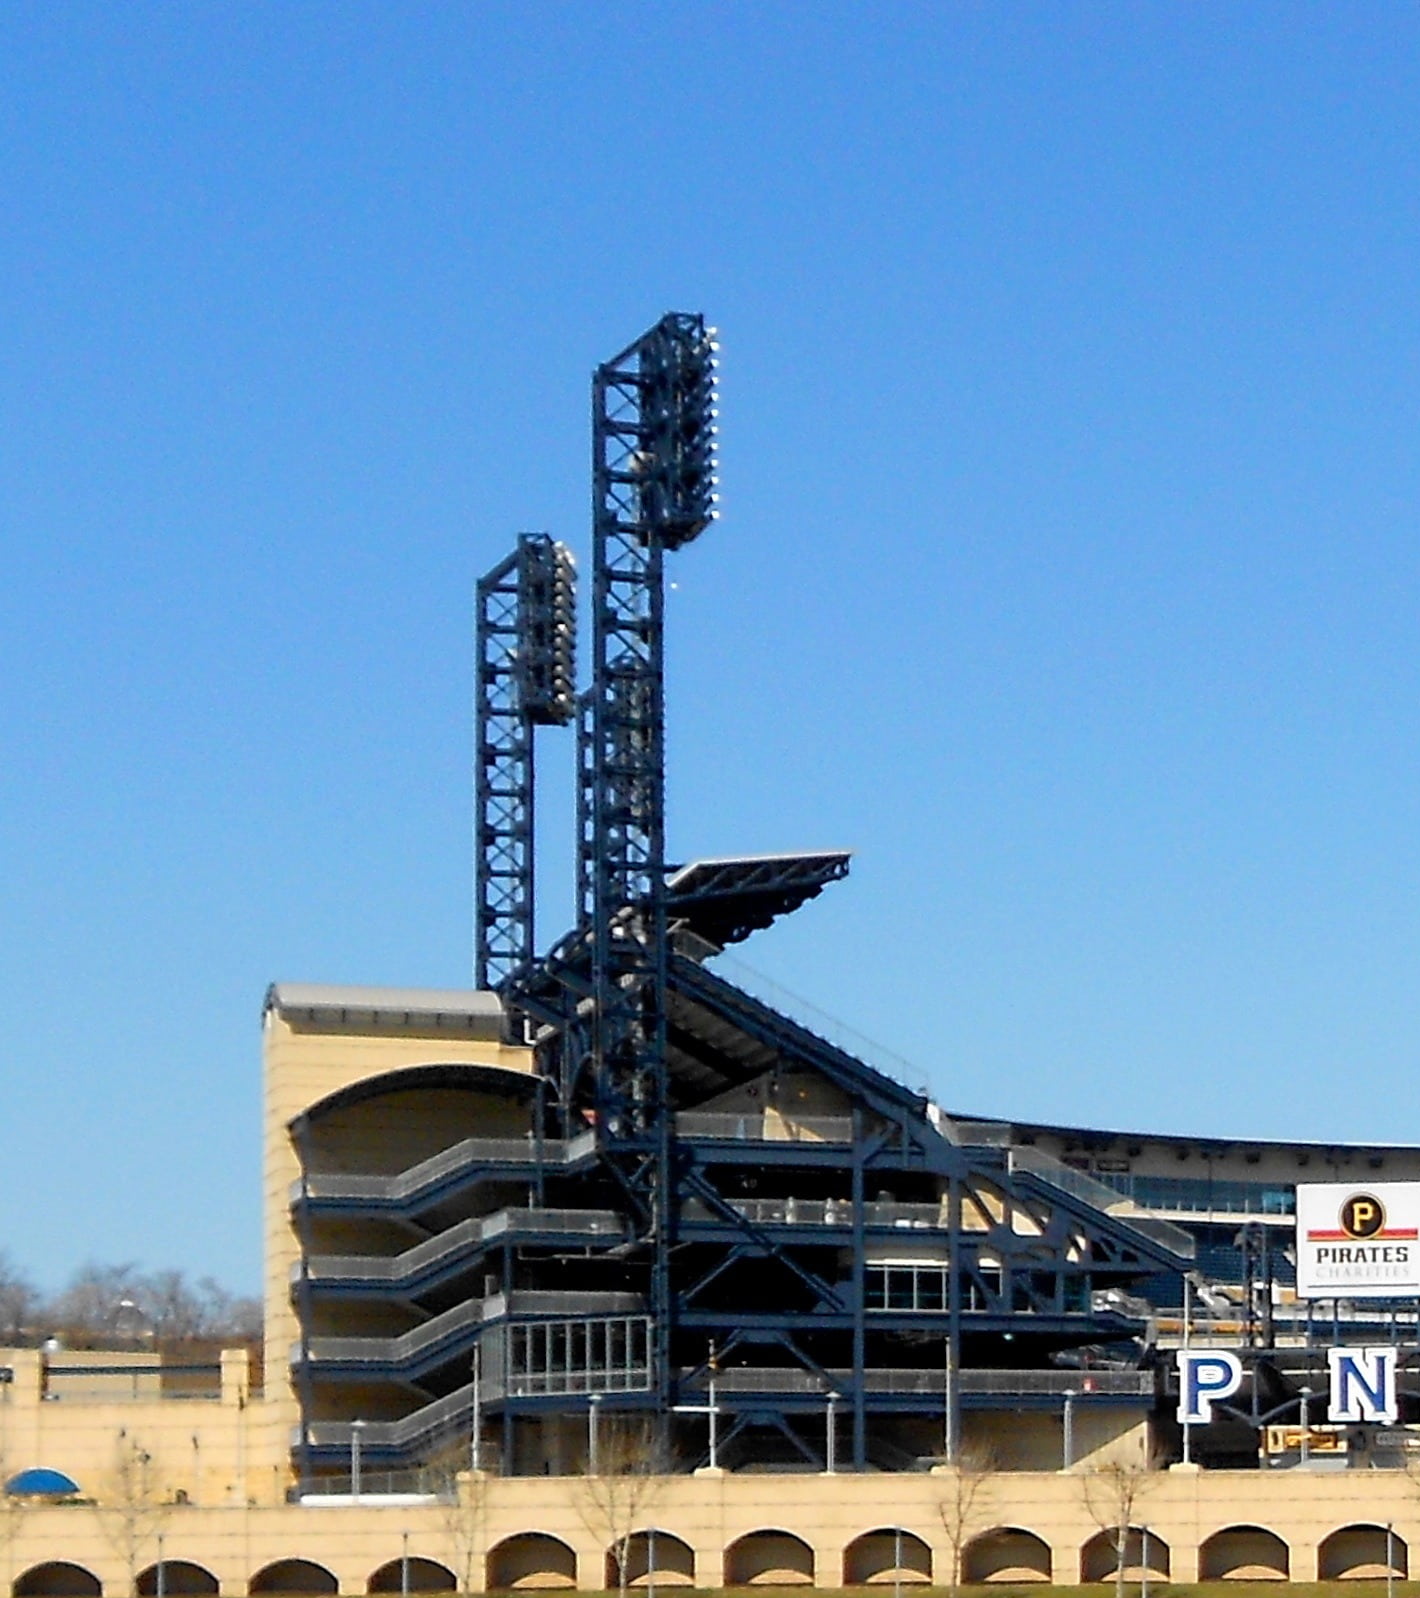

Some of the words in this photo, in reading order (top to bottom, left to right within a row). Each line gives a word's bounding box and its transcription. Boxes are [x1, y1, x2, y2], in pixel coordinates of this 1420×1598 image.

[1353, 1202, 1373, 1232] P
[1316, 1247, 1408, 1264] PIRATES
[1316, 1266, 1409, 1279] CHARITIES
